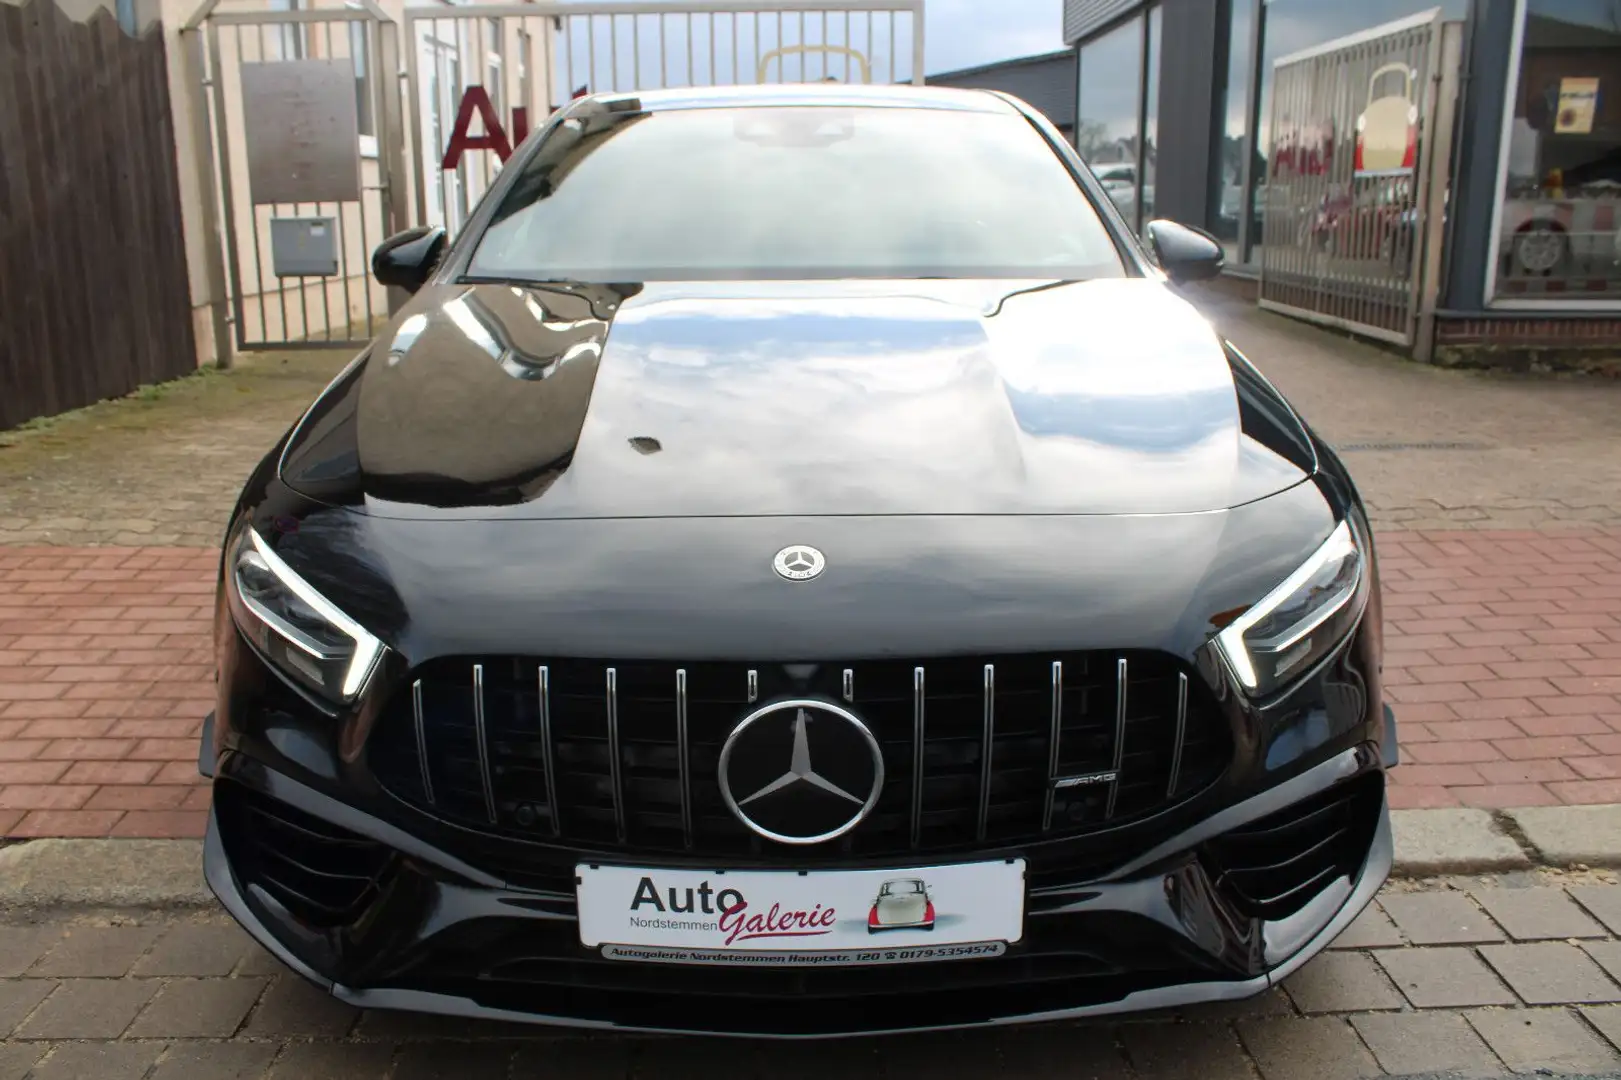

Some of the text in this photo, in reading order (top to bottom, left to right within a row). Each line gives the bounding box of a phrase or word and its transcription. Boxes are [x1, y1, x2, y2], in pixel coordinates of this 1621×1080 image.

[630, 877, 744, 914] Auto
[630, 916, 718, 931] Nordstemmen
[719, 900, 836, 945] Galerie
[611, 944, 998, 964] Autogalerie Nordstemmen Hauptstr. 120 0179-5354574
